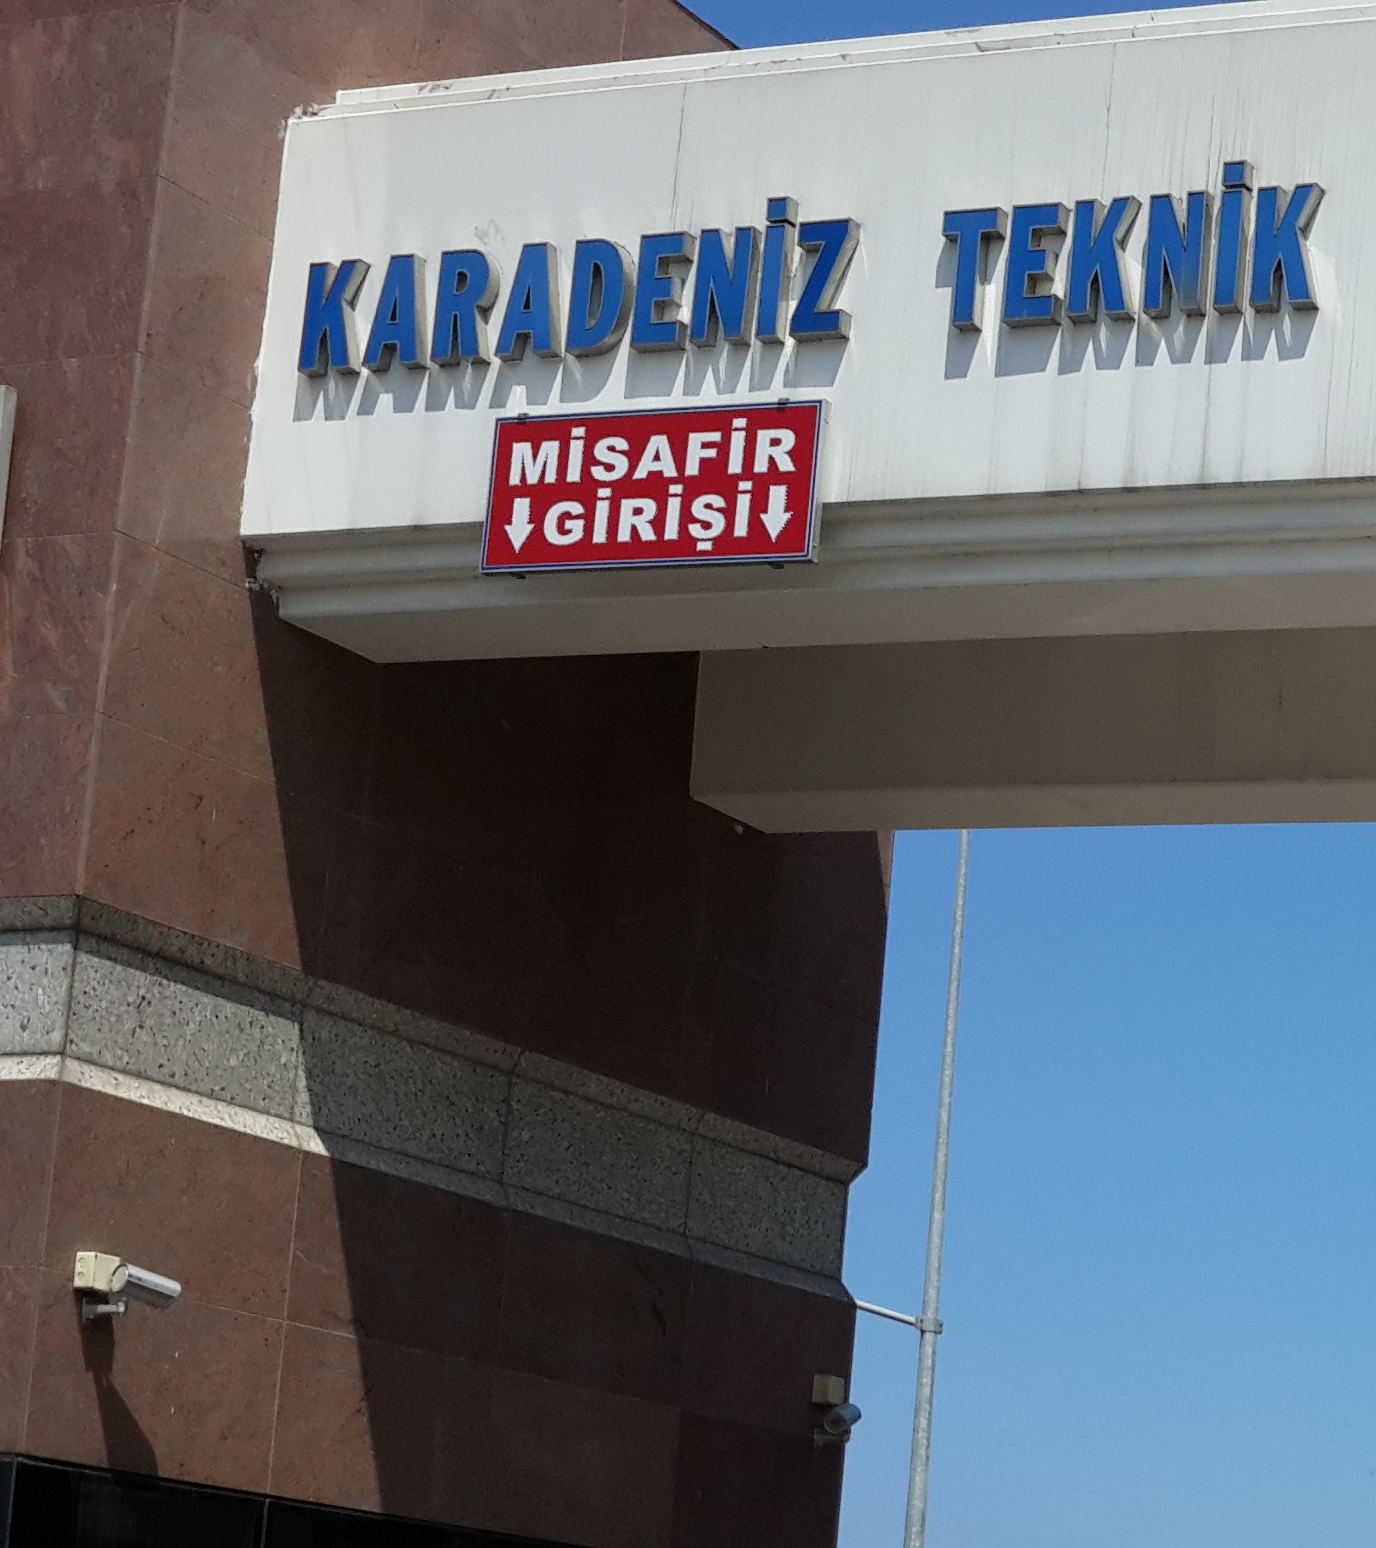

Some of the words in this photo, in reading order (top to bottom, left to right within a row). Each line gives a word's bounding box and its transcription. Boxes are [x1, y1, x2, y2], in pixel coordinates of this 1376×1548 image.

[298, 196, 861, 376] KARADENİZ
[942, 160, 1323, 331] TEKNİK
[508, 417, 796, 486] MİSAFİR
[543, 480, 753, 552] GİRİŞİ
